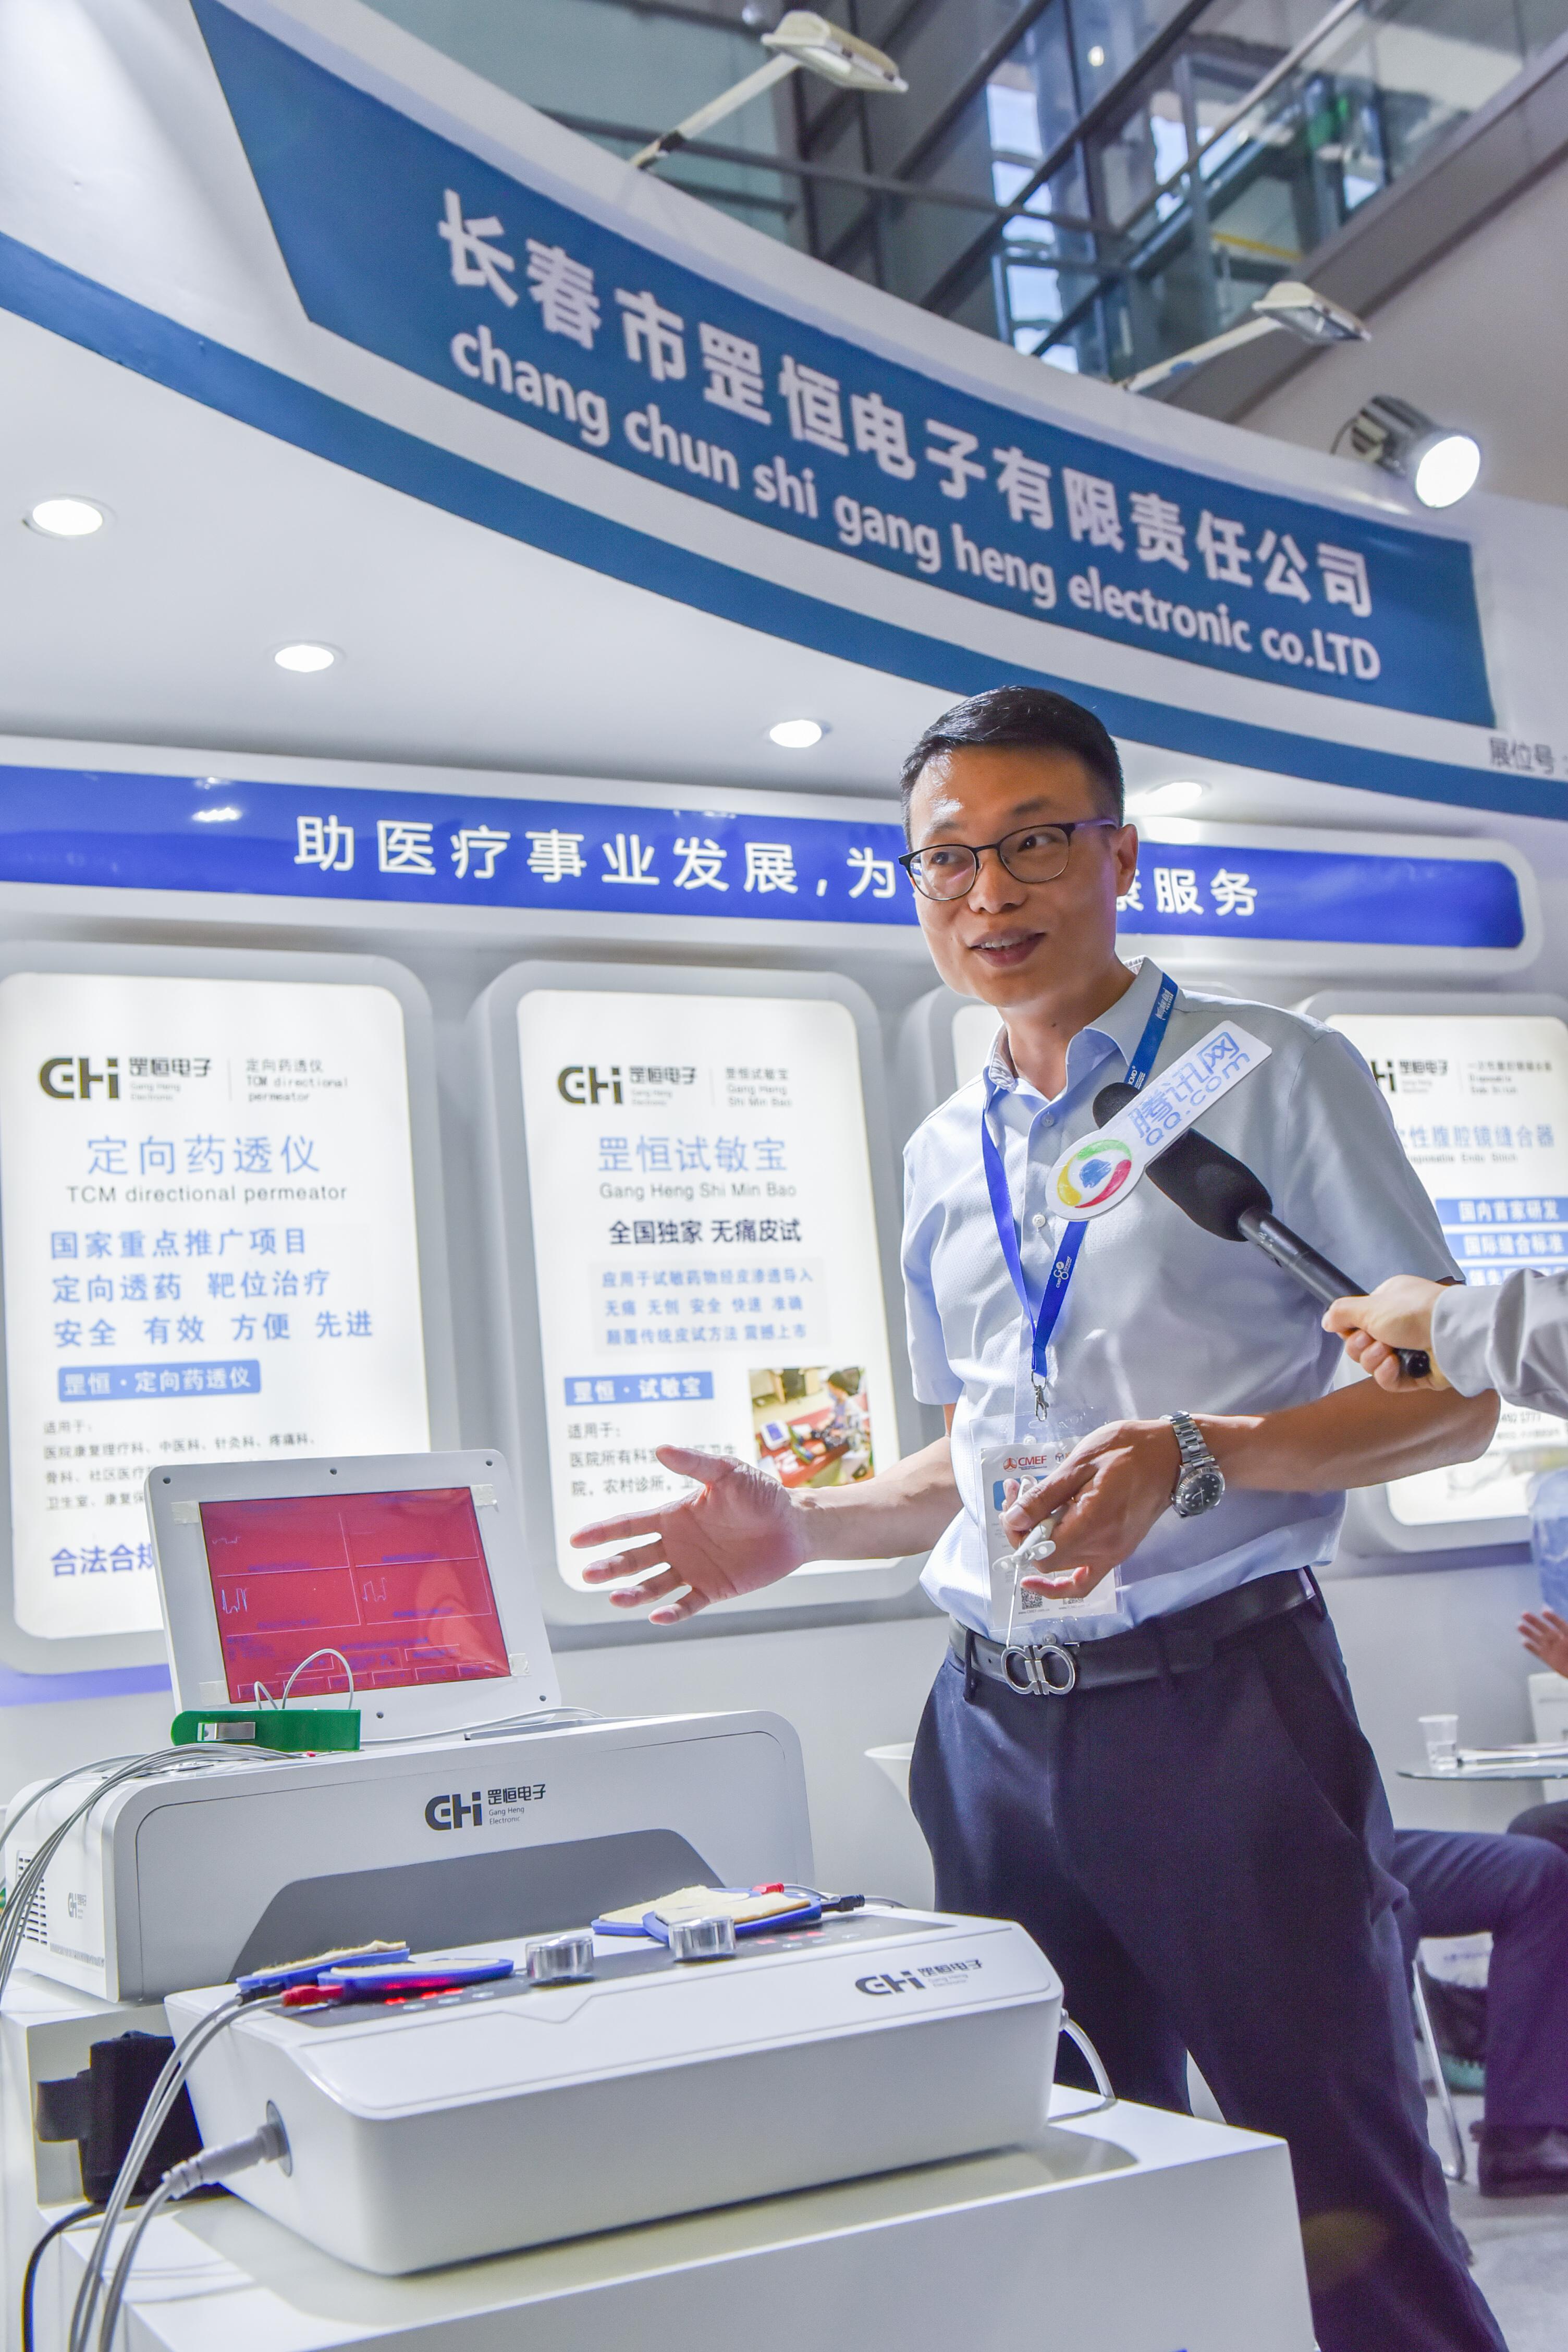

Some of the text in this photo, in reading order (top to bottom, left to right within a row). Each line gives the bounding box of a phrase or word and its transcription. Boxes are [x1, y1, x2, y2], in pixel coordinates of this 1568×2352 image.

[438, 189, 1373, 618] 长春市罡恒电子有限责任公司
[450, 325, 1382, 681] chang chun shi gang heng electronic co.LTD
[129, 1057, 212, 1077] 罡恒电子
[247, 1075, 349, 1087] TCM directional
[248, 1092, 311, 1102] permeator
[1145, 1052, 1251, 1147] QQ.com
[87, 1134, 321, 1176] 定向药透仪
[598, 1135, 788, 1174] 罡恒试敏宝
[67, 1184, 348, 1205] TCM directional permeator
[599, 1181, 797, 1202] Gang Heng Shi Min Bao
[609, 1218, 802, 1246] 全国独家 无痛皮试
[51, 1228, 307, 1260] 国家重点推广项目
[52, 1269, 332, 1304] 定向透药 靶位治疗
[605, 1295, 803, 1317] 无痛 无创 安全 快速 准确
[54, 1309, 374, 1349] 安全 有效 方便 先进
[744, 1323, 807, 1340] 震撼上市
[1018, 1455, 1047, 1466] CMEF
[488, 1783, 546, 1805] 罡恒电子
[488, 1806, 525, 1817] Gang Heng
[489, 1816, 521, 1825] Electronic
